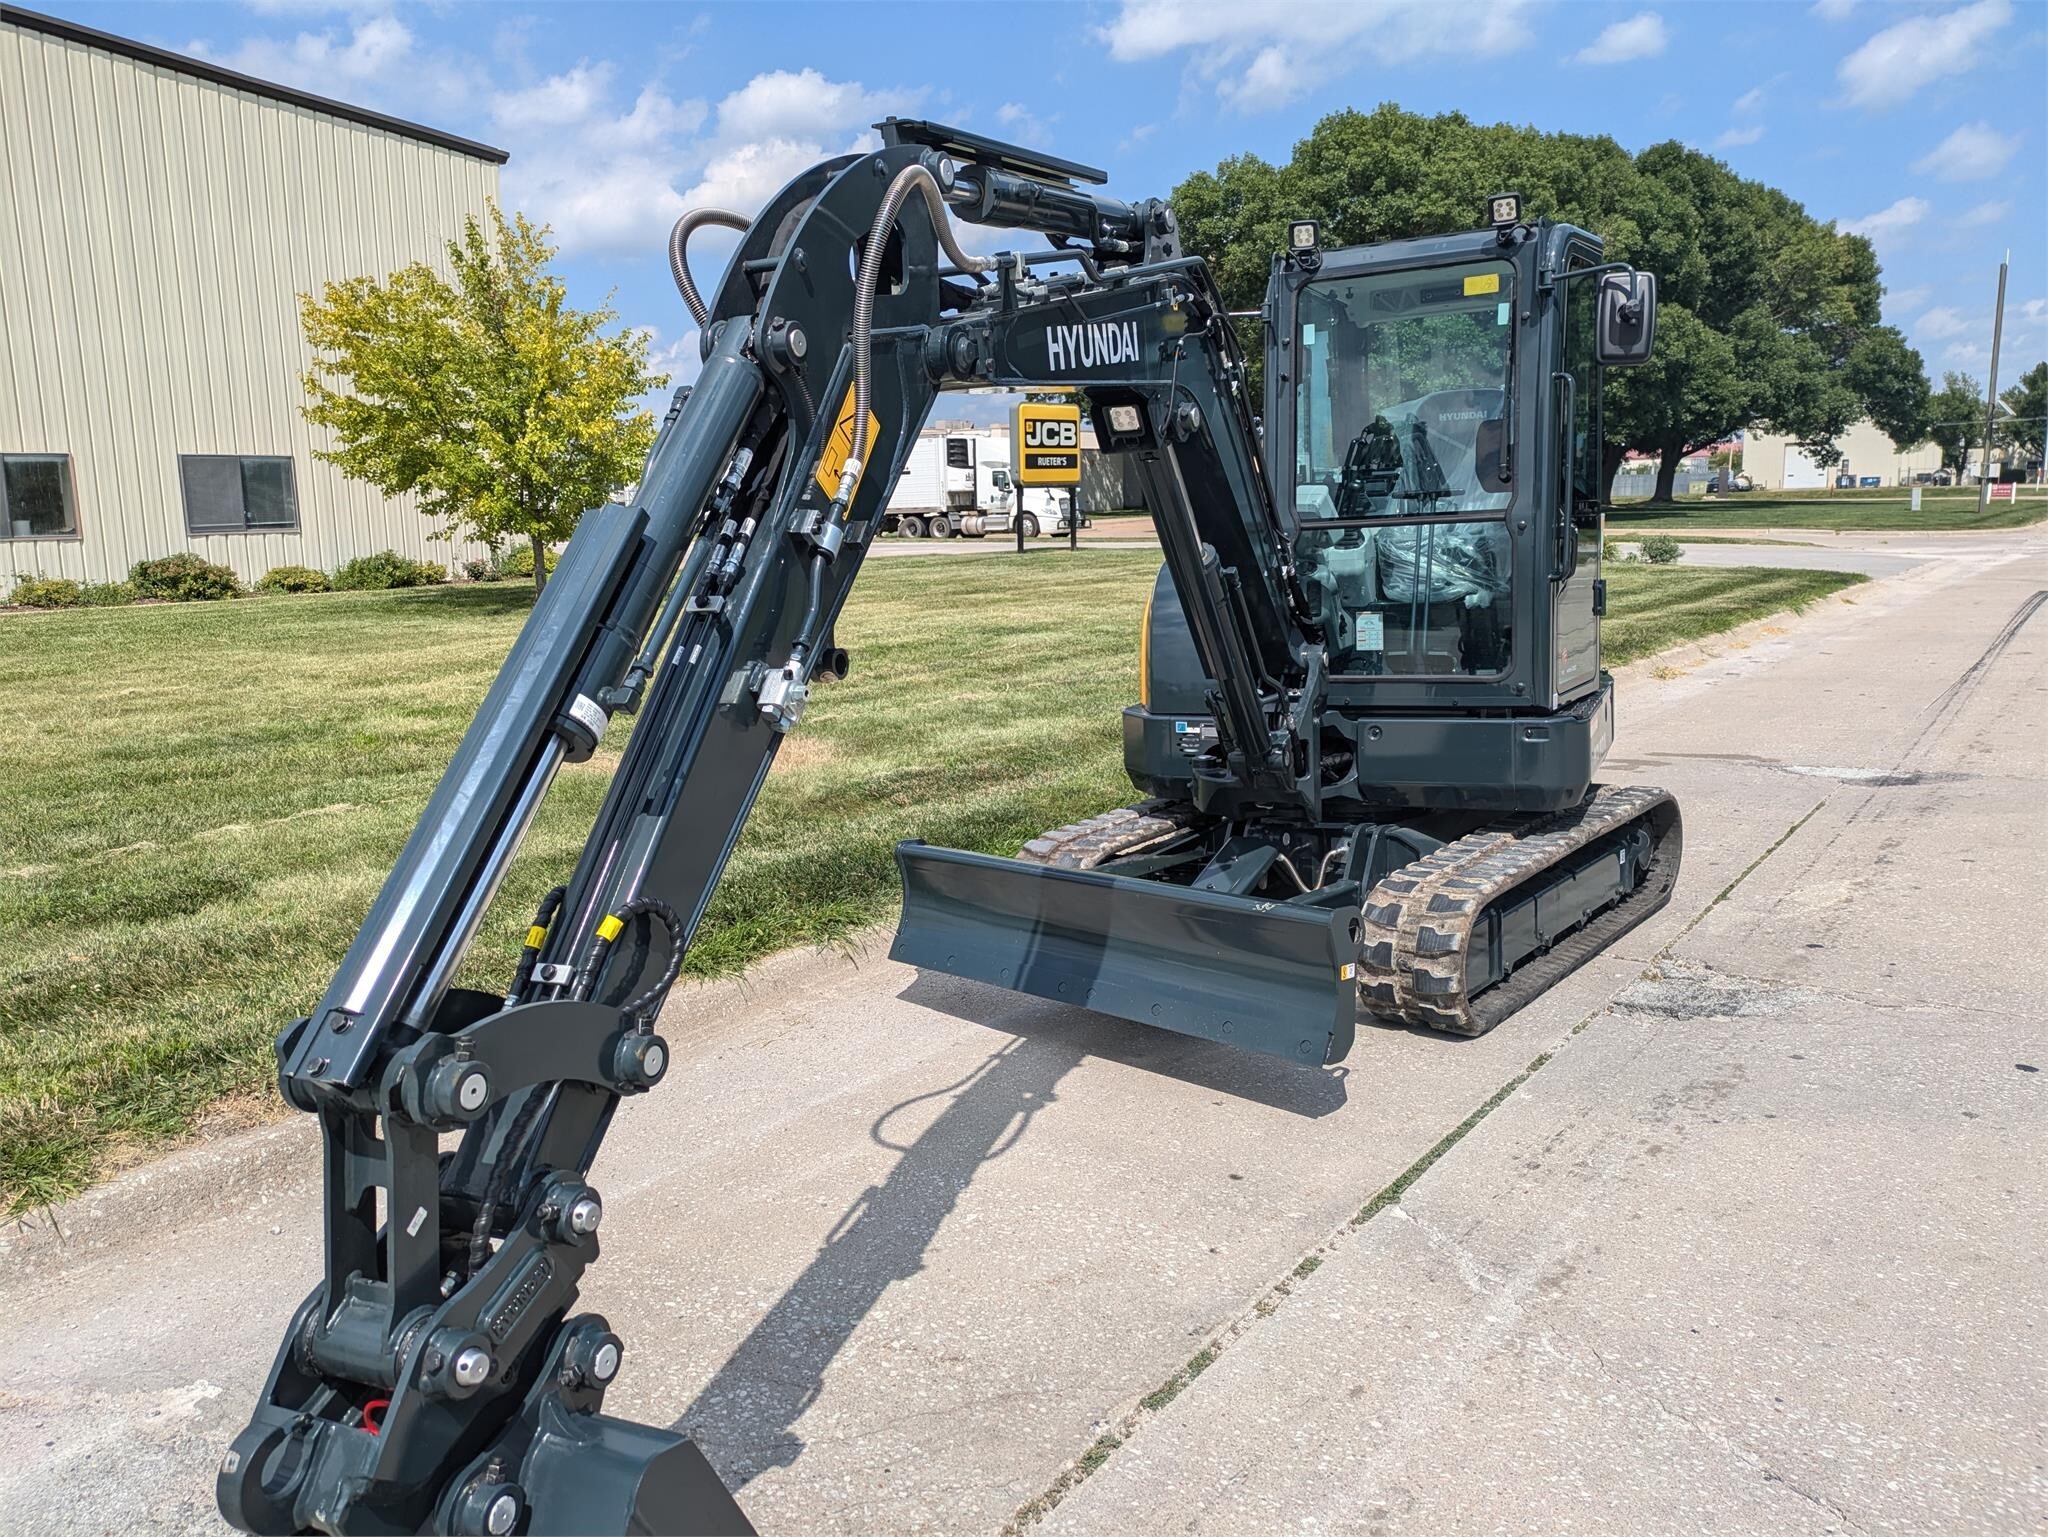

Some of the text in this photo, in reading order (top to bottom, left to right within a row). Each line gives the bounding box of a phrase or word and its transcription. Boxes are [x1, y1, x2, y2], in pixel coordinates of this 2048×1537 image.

[1046, 321, 1140, 372] HYUNDAI
[1439, 410, 1488, 421] HYUNDAI
[1026, 421, 1077, 447] JCB
[1037, 457, 1067, 467] RUETER'S
